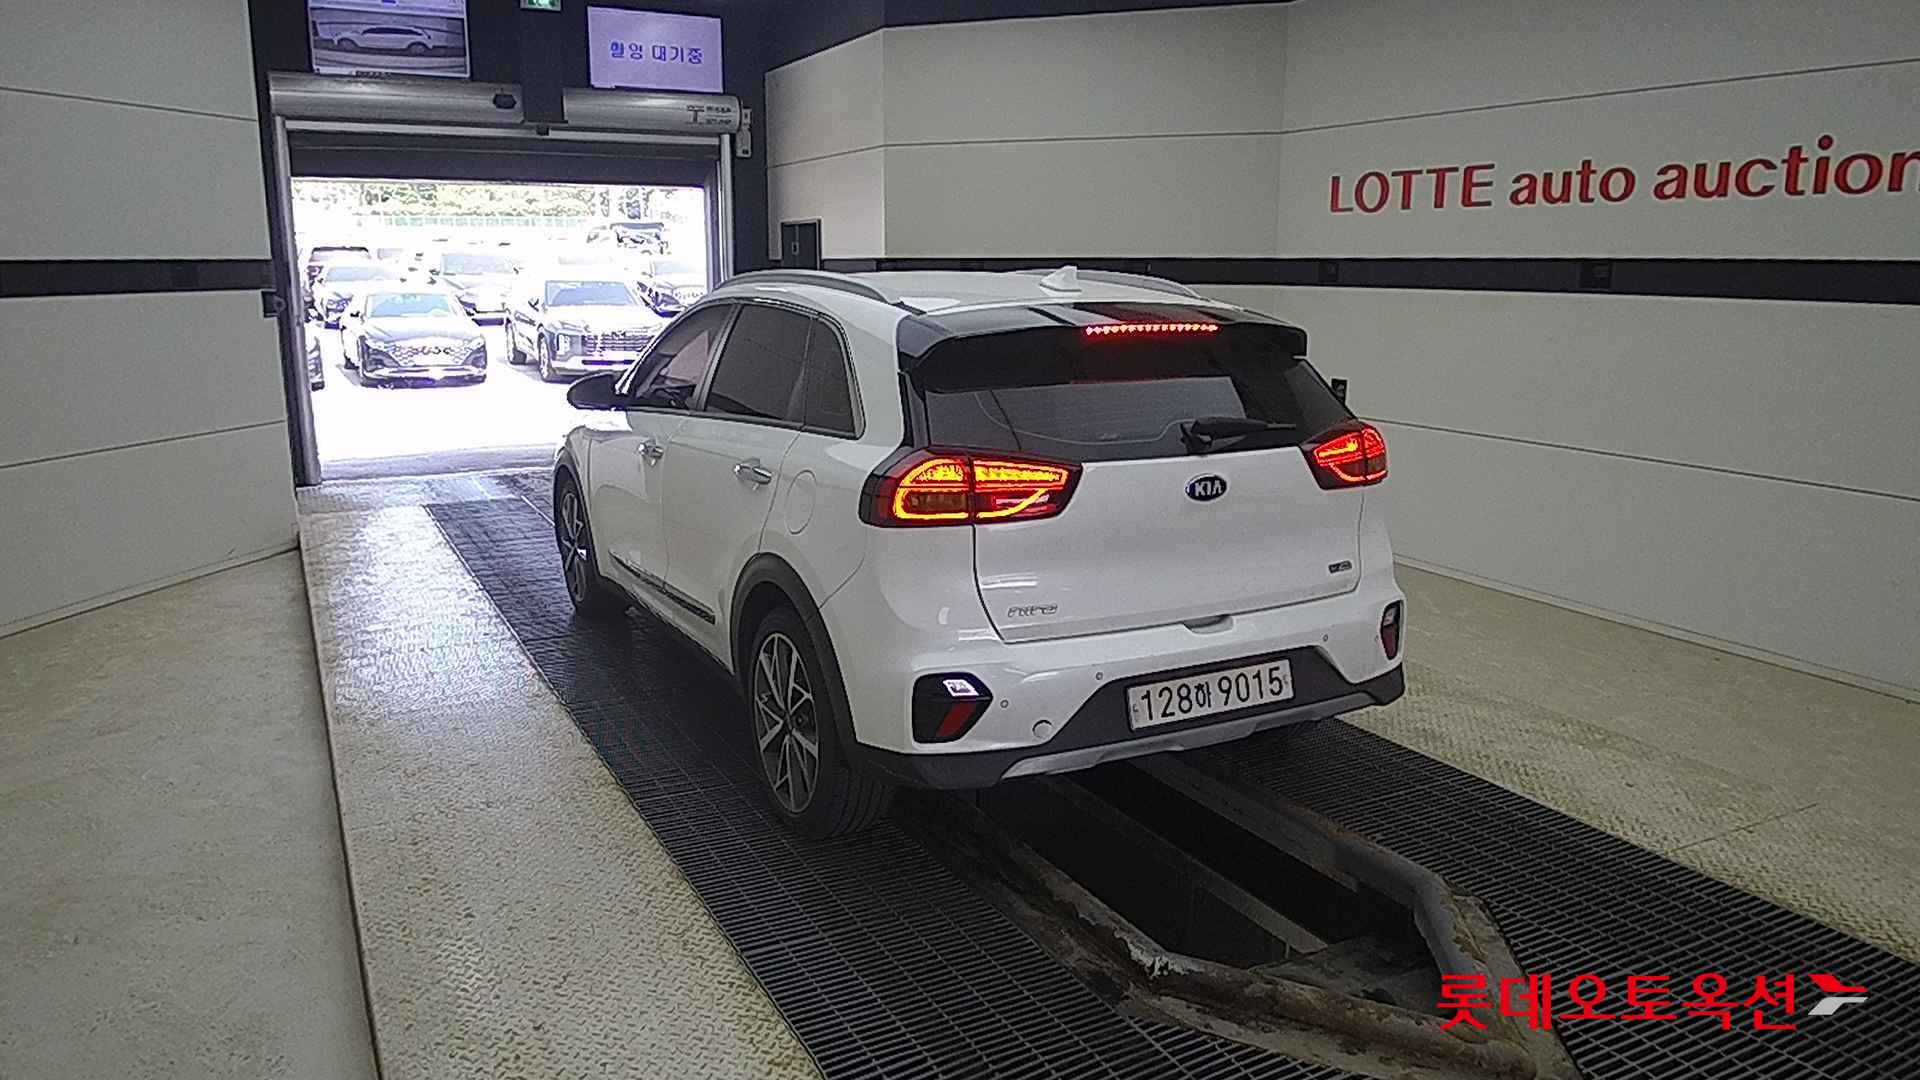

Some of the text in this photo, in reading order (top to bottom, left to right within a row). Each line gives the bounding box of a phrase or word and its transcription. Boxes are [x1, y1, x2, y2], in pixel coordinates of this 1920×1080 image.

[652, 44, 703, 65] 대기중
[1330, 163, 1495, 214] LOTTE
[1508, 159, 1637, 206] auto
[1194, 479, 1222, 497] KIA
